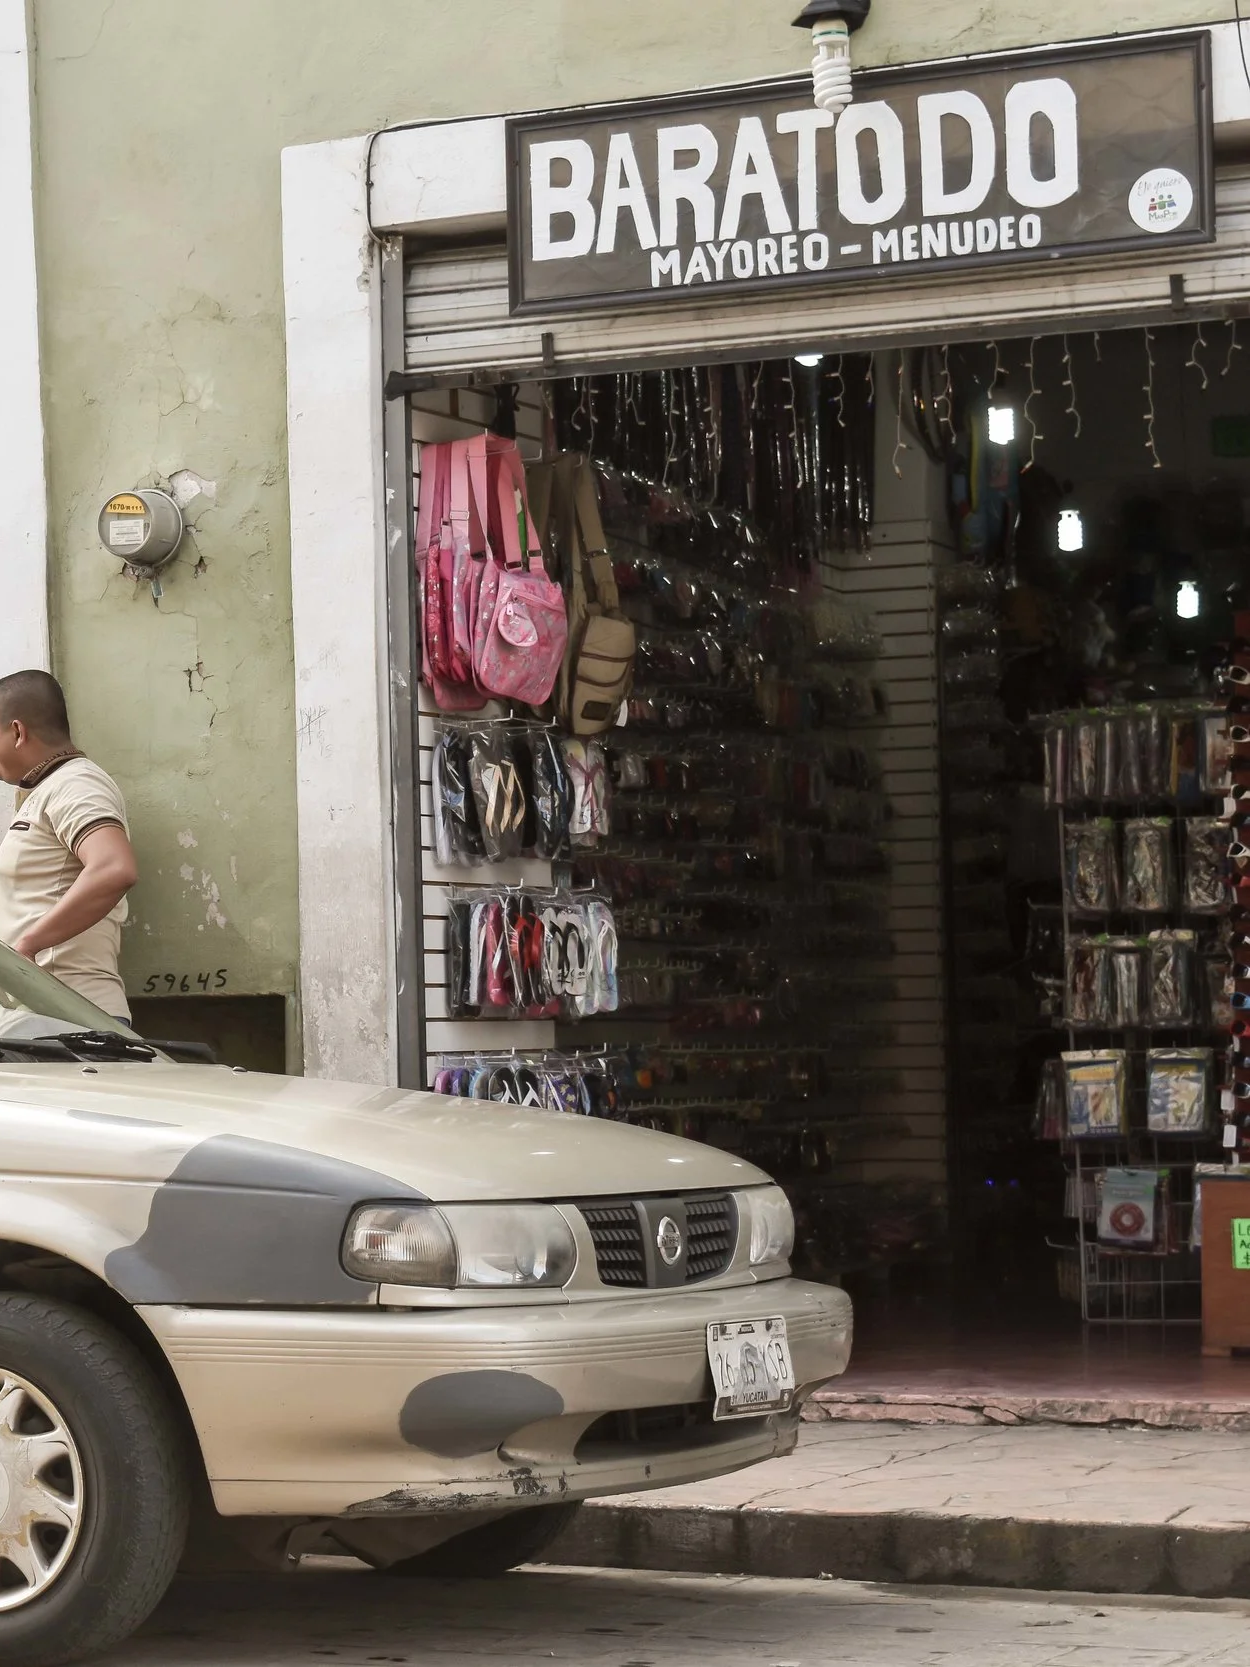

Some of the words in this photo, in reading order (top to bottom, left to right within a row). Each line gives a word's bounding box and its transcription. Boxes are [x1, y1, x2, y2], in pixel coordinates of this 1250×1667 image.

[529, 77, 1079, 261] BARATODO
[650, 232, 830, 288] MAYOREO
[872, 213, 1042, 265] MENUDEO
[143, 968, 228, 993] 59645
[743, 1390, 768, 1403] YUCATAN
